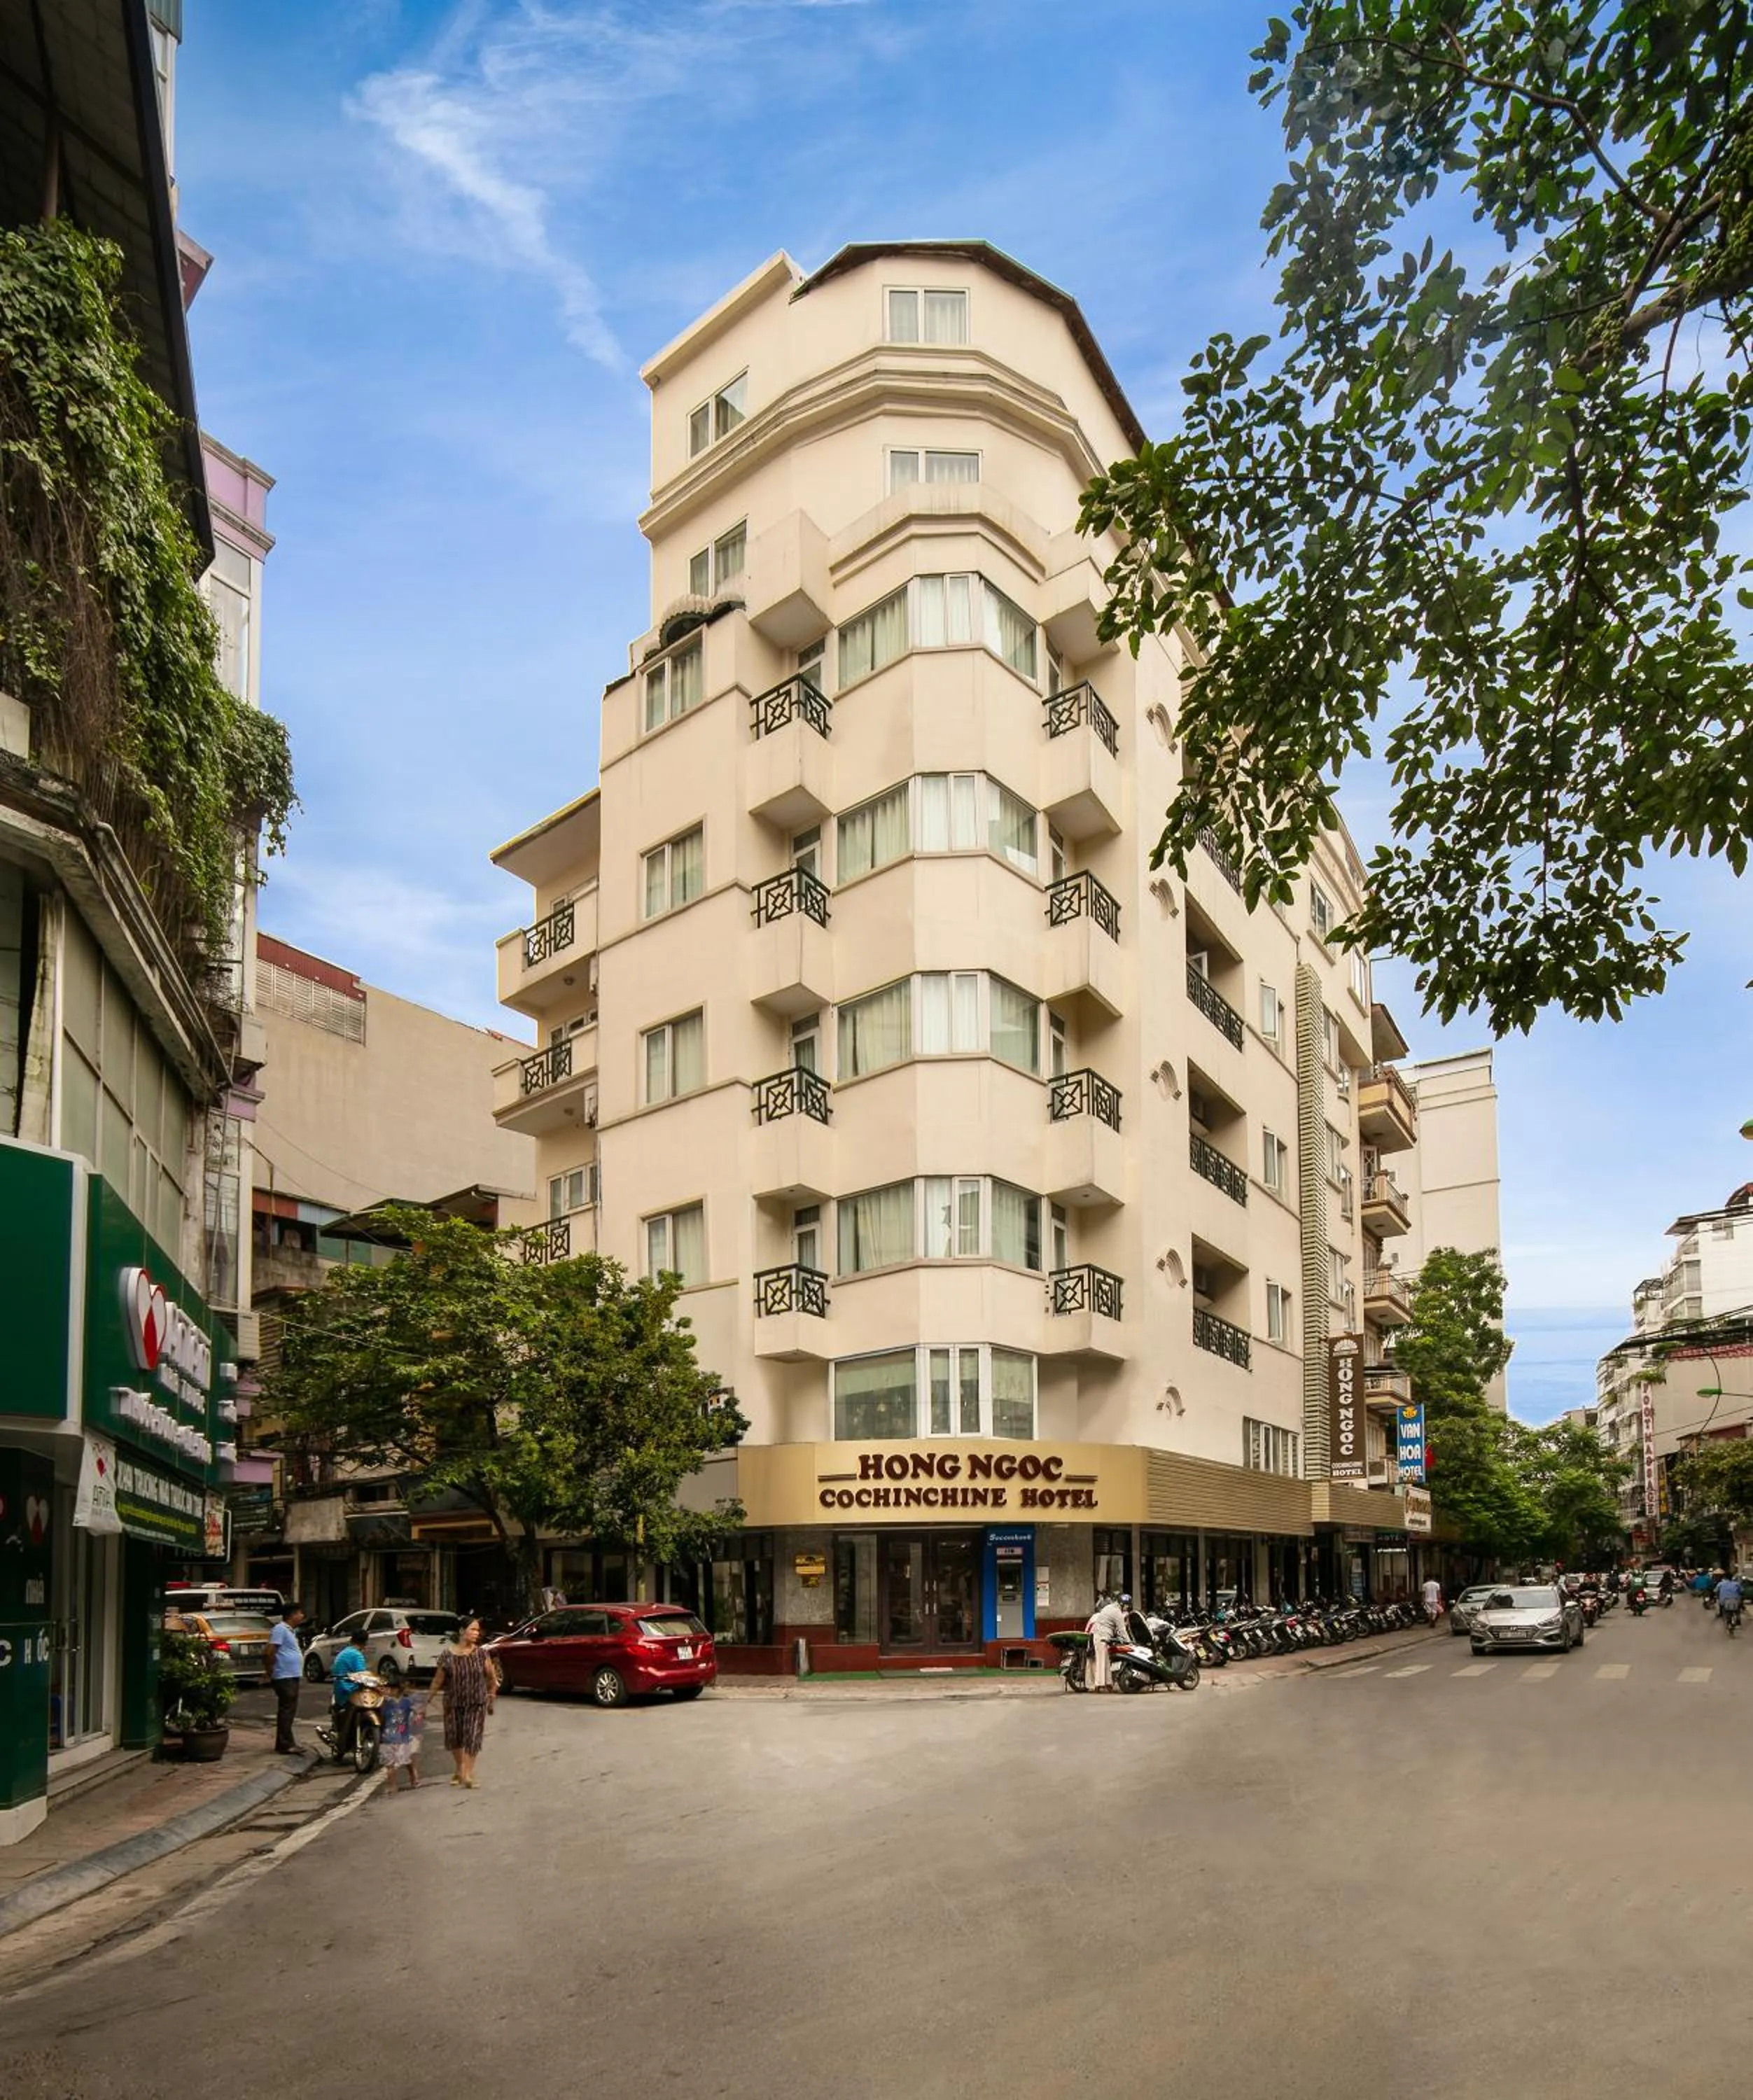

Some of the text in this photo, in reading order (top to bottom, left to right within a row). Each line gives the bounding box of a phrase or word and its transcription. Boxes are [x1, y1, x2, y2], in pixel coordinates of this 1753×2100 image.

[1338, 1358, 1353, 1405] HONG
[1339, 1408, 1355, 1455] NGOC
[1399, 1422, 1420, 1439] VAN
[1399, 1445, 1421, 1460] HOA
[858, 1452, 1063, 1480] HONG NGOC
[1332, 1468, 1364, 1477] HOTEL
[1398, 1465, 1423, 1476] HOTEL
[818, 1488, 1098, 1508] COCHINCHINE HOTEL
